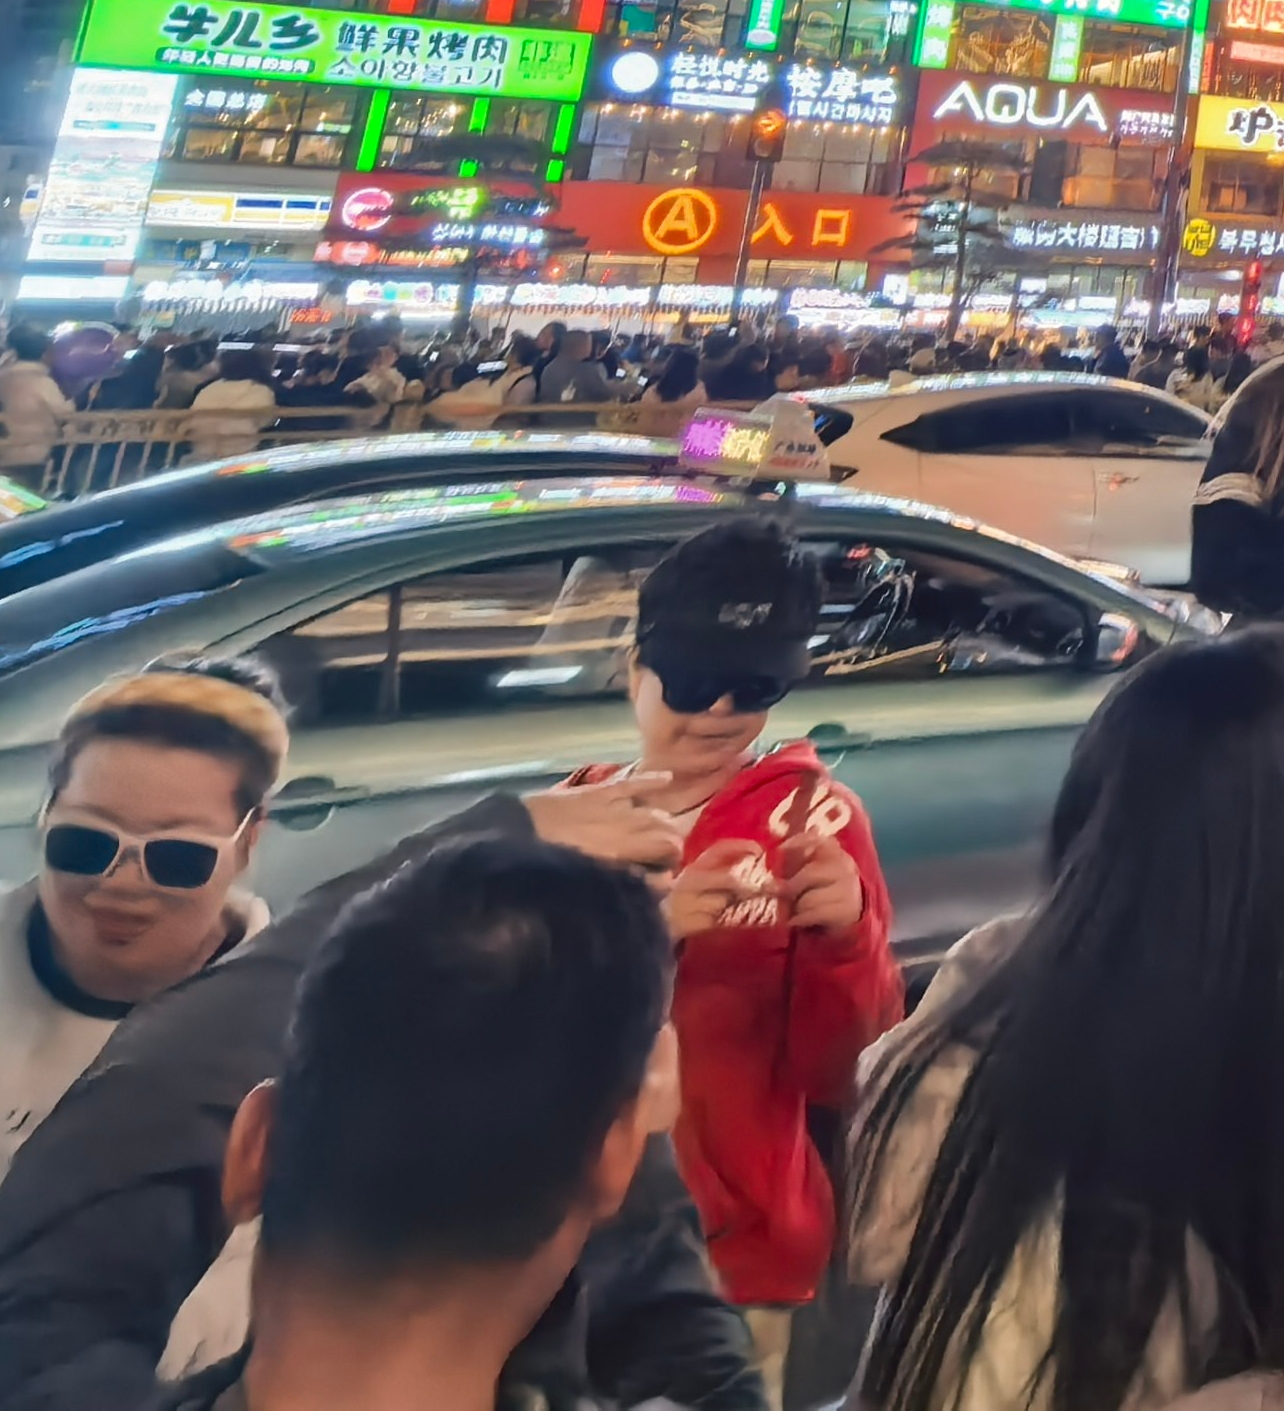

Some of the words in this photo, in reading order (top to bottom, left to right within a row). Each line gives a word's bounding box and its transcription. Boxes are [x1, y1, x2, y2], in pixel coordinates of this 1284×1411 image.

[336, 20, 508, 64] 鲜果烤肉
[933, 80, 1108, 132] AQUA
[652, 194, 699, 240] A
[749, 203, 852, 247] 入口
